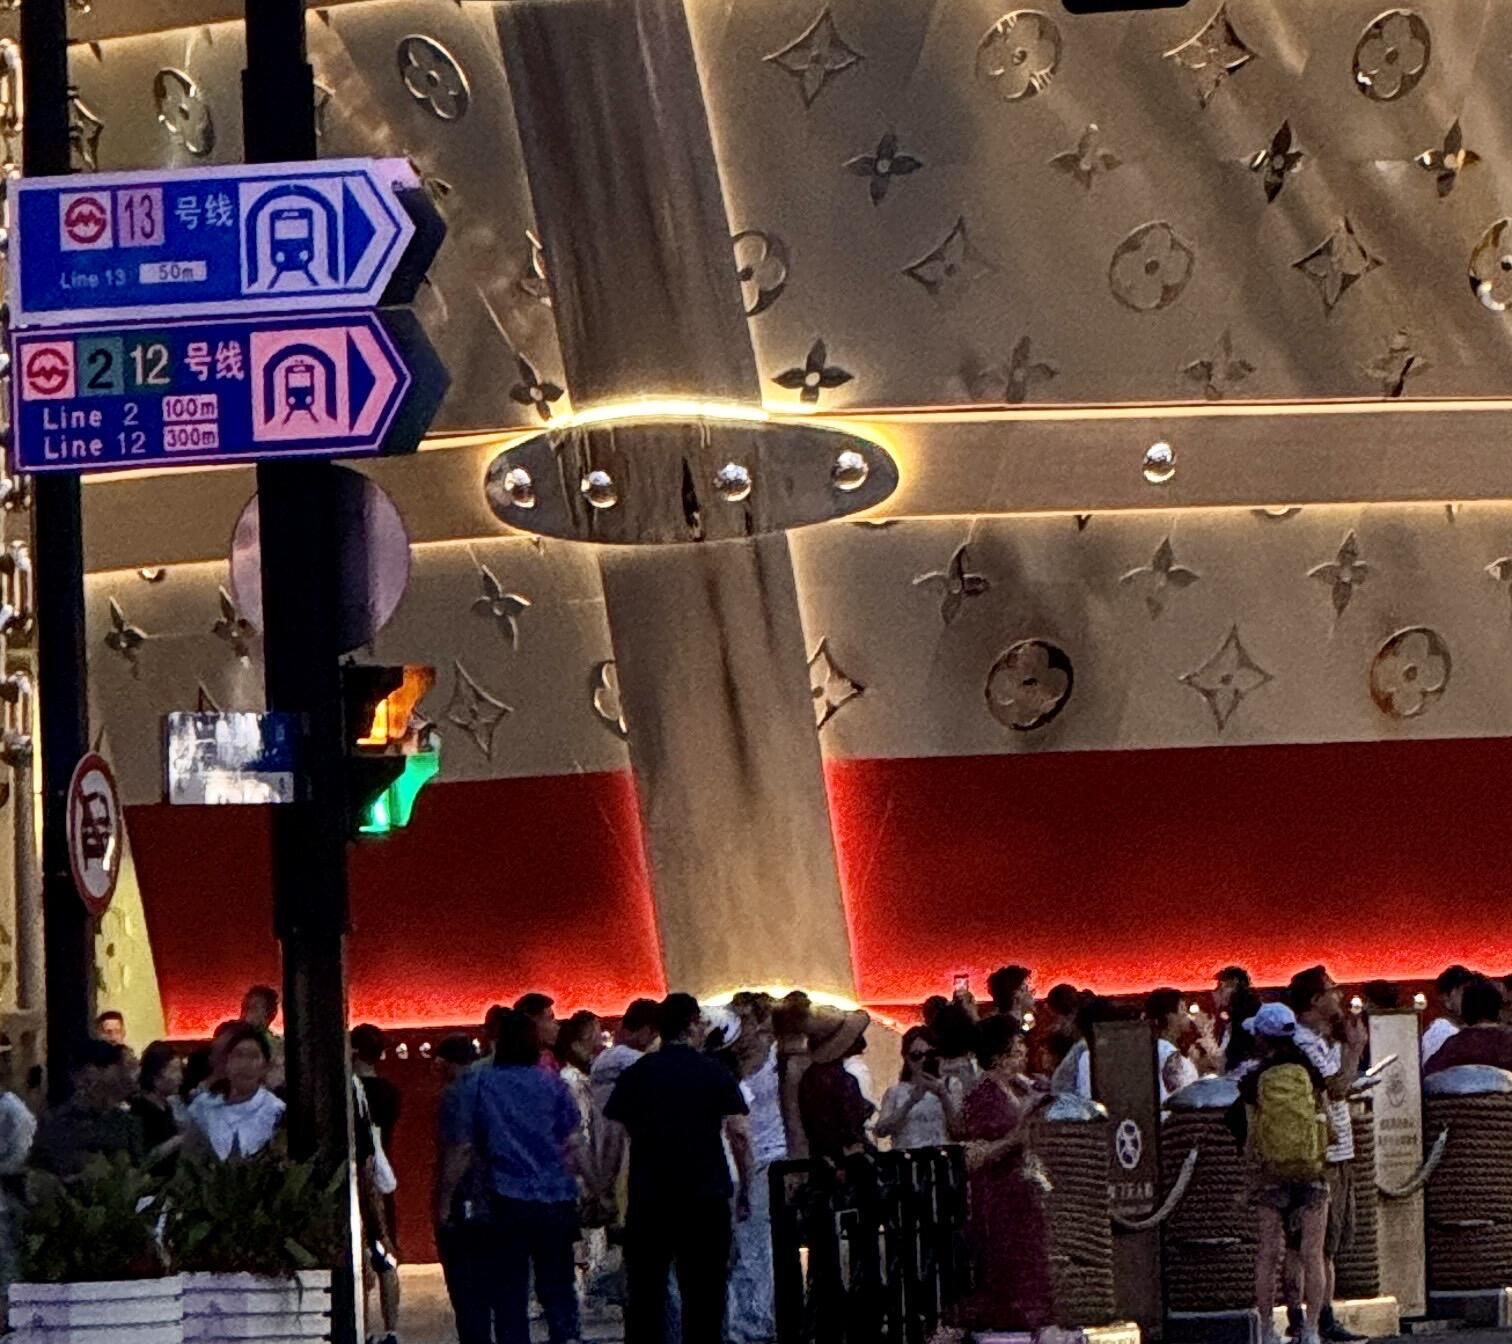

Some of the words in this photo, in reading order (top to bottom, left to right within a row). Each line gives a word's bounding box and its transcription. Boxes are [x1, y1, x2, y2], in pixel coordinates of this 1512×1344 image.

[124, 193, 156, 241] 13
[175, 194, 234, 230] 号线
[61, 272, 98, 289] Line
[159, 265, 194, 281] 50m
[86, 349, 114, 390] 2
[130, 344, 171, 385] 12
[184, 341, 245, 382] 号线
[43, 407, 102, 430] Line
[123, 403, 139, 426] 2
[165, 397, 217, 418] 100m
[44, 436, 103, 459] Line
[117, 433, 146, 454] 12
[165, 427, 218, 448] 300m
